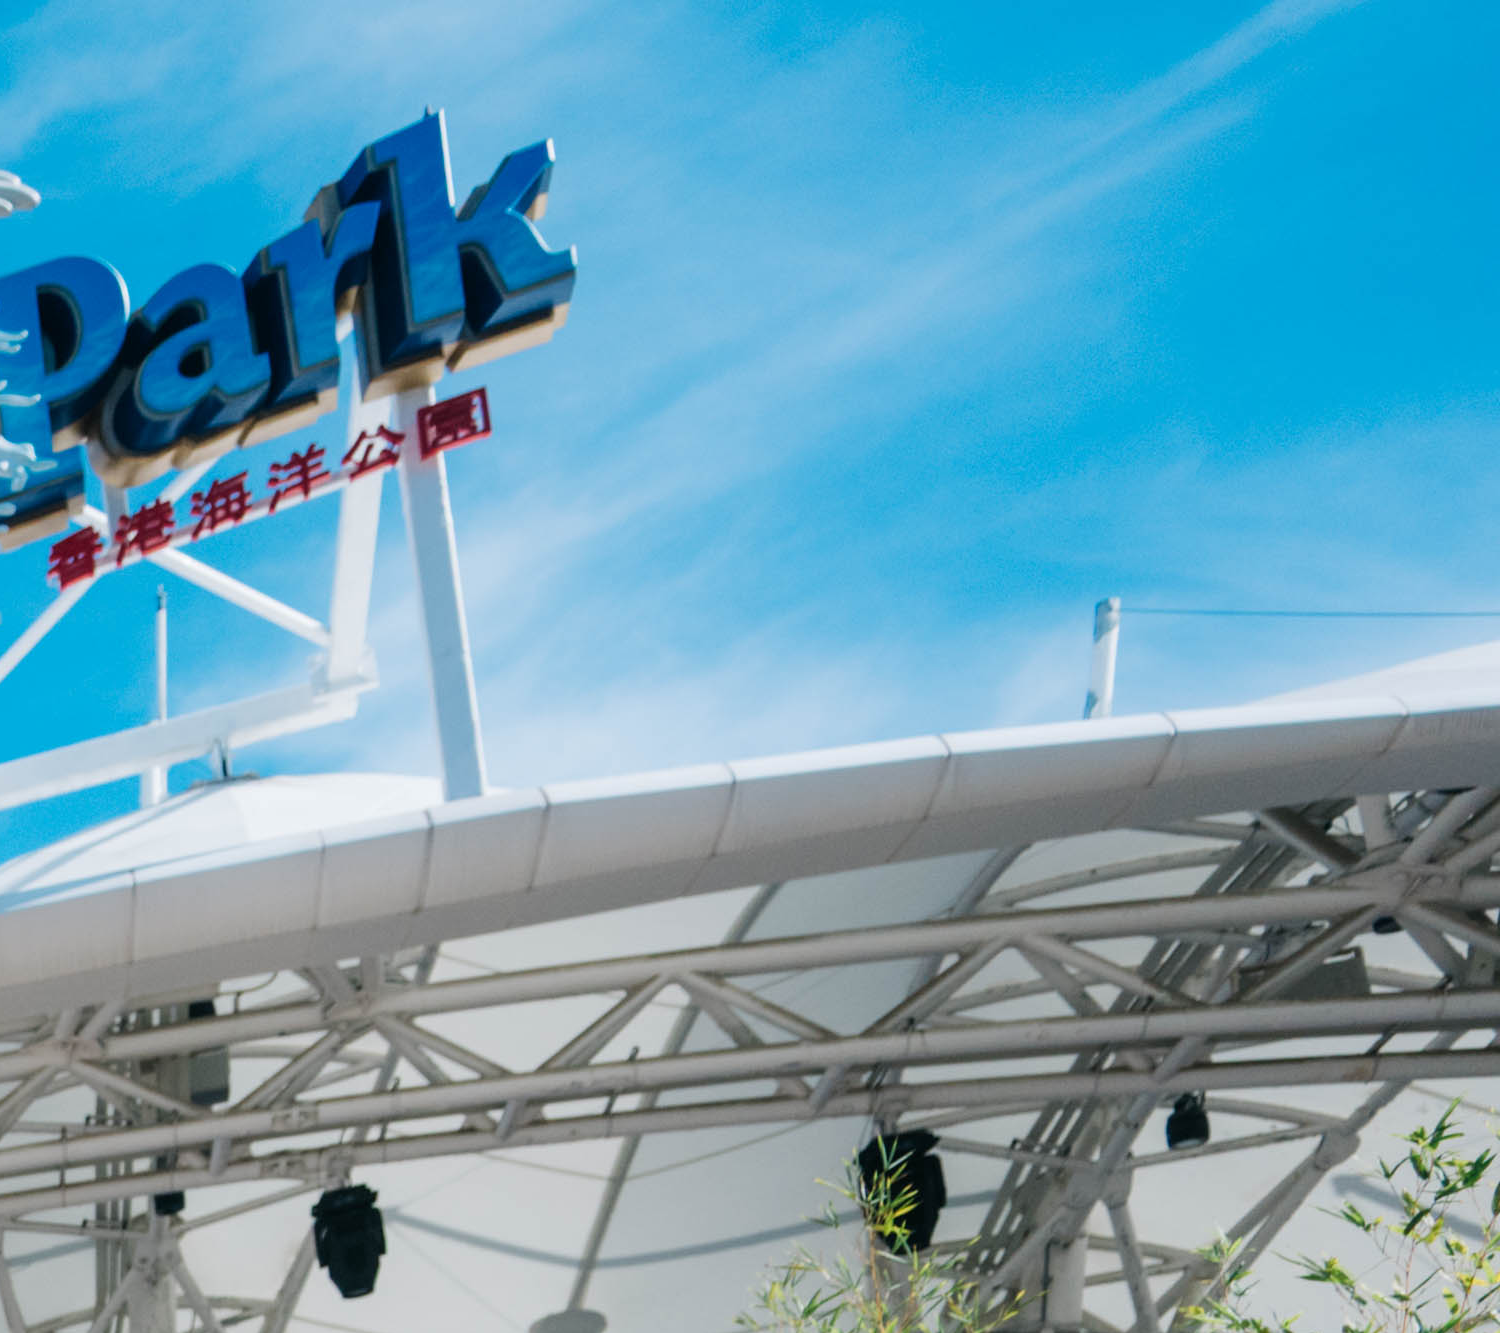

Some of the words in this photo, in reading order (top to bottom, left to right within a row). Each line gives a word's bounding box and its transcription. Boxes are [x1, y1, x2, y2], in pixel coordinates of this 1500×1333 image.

[48, 387, 492, 590] 香港海洋公園
